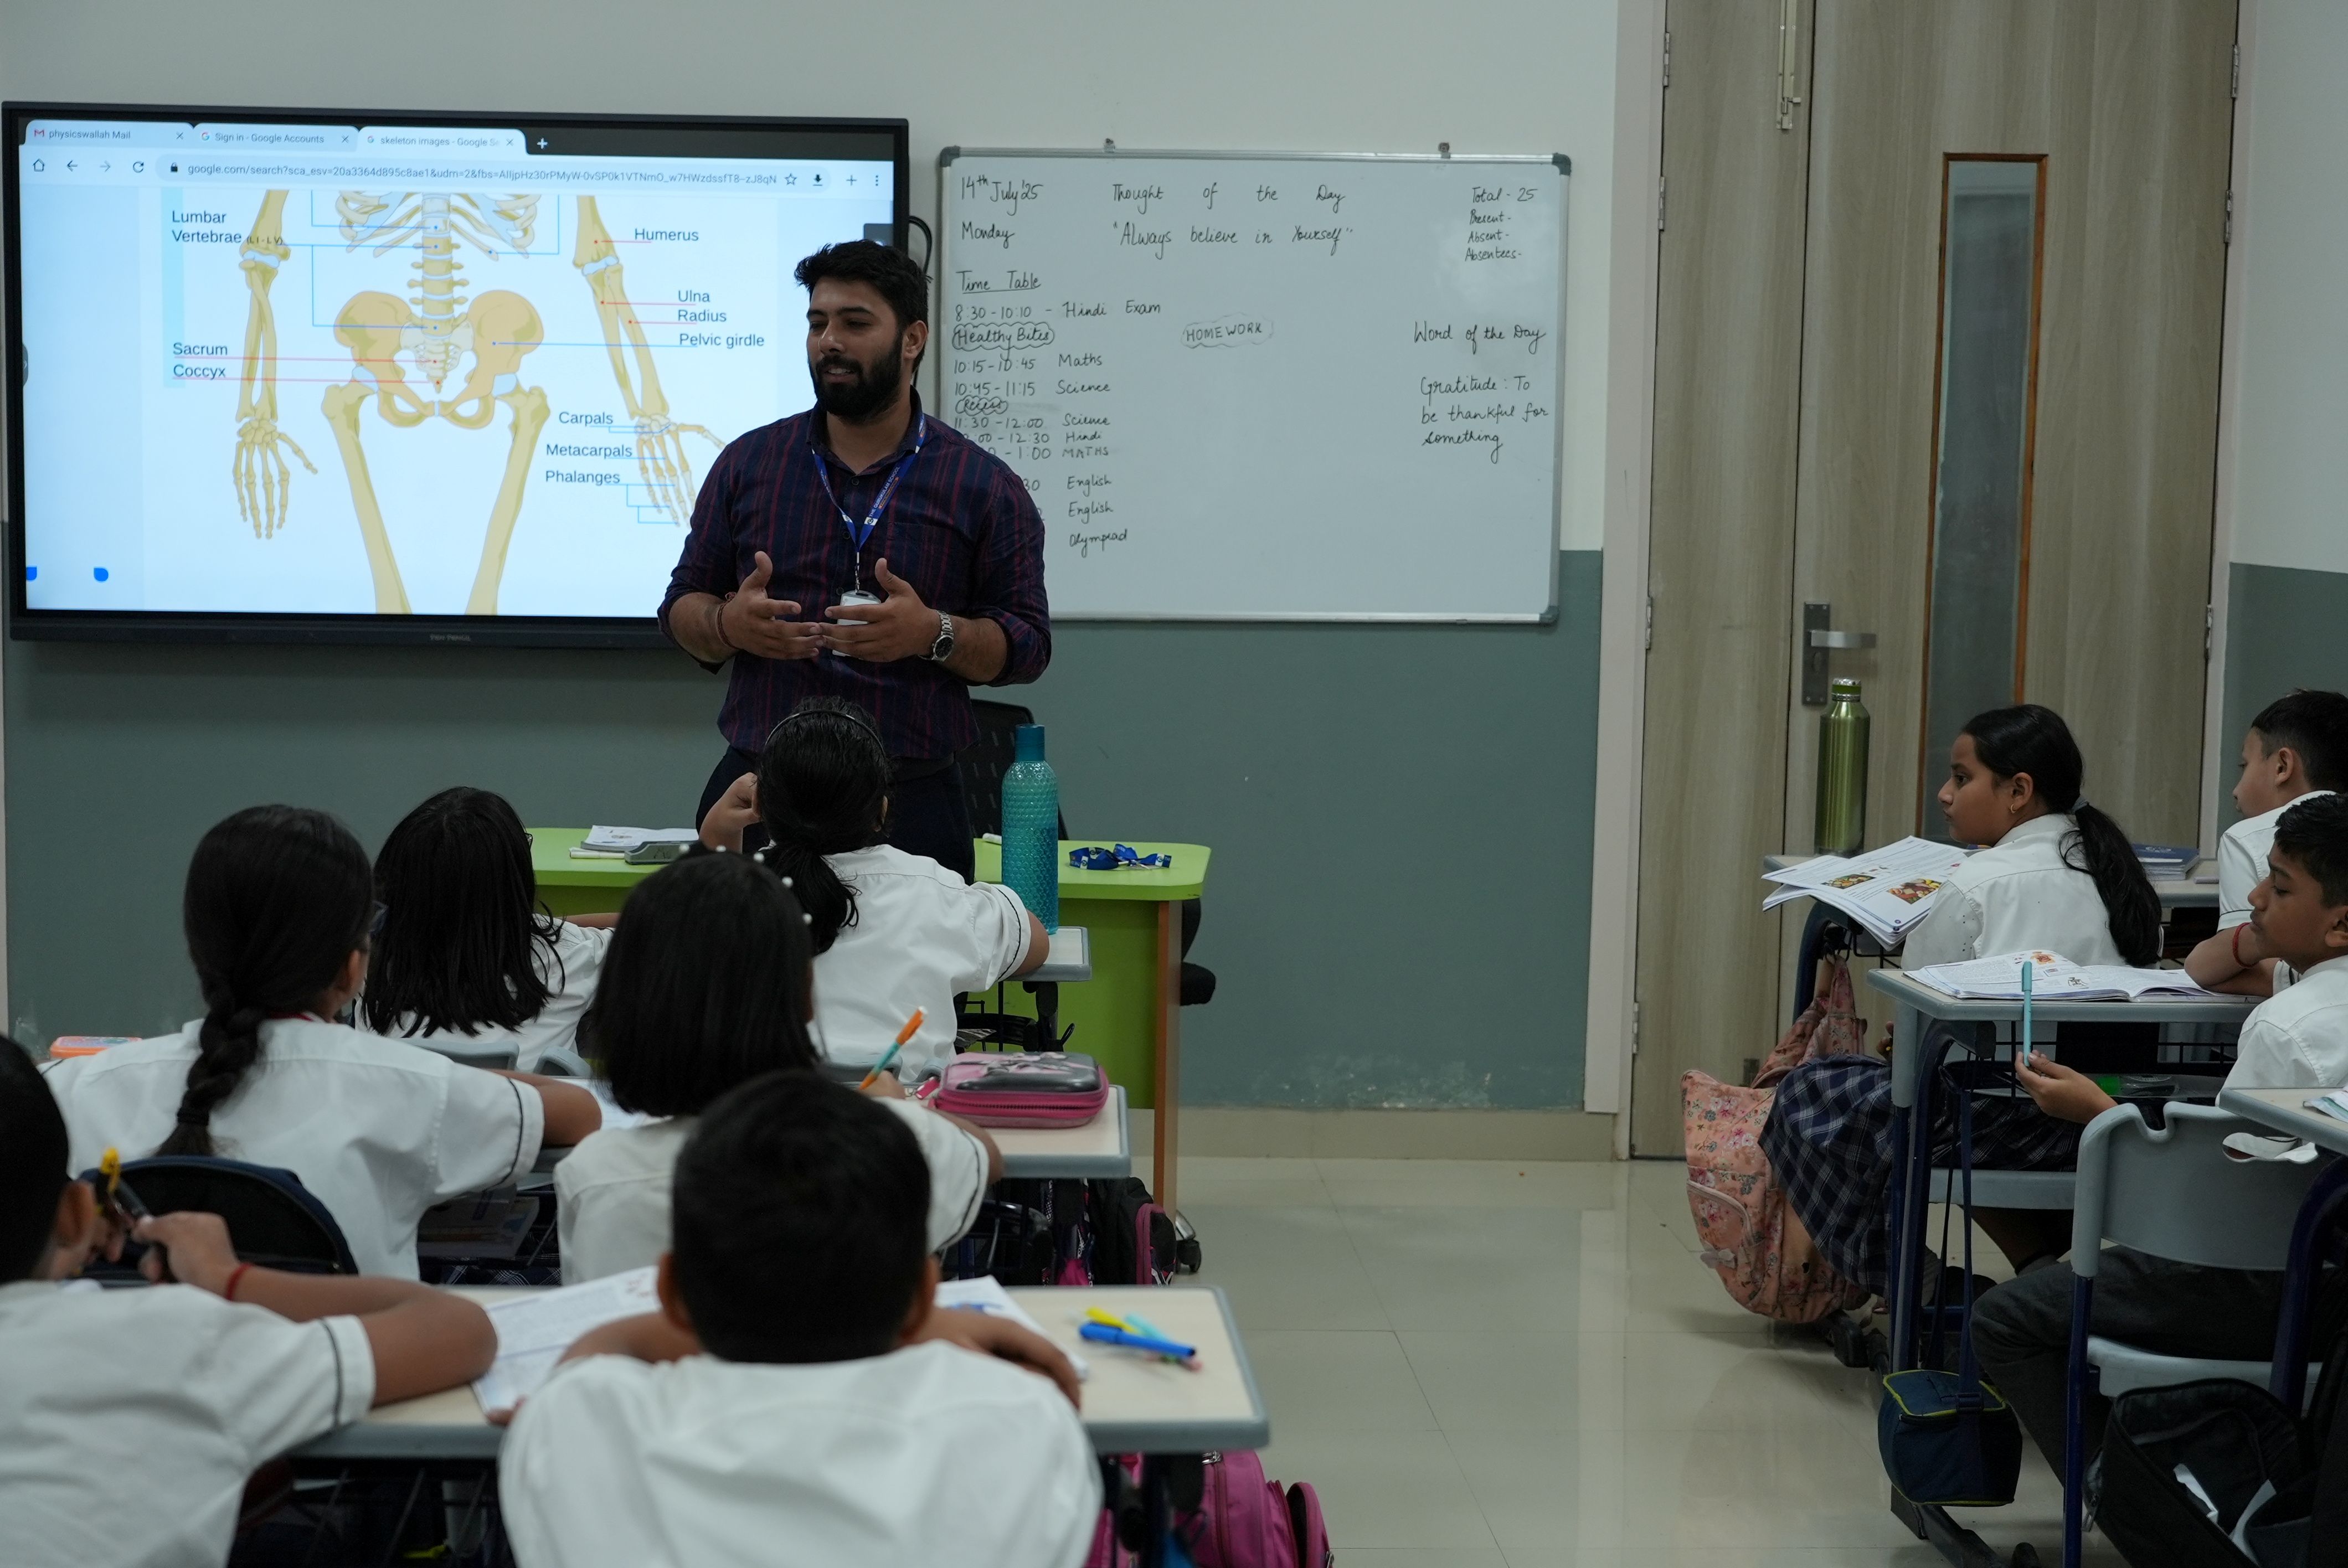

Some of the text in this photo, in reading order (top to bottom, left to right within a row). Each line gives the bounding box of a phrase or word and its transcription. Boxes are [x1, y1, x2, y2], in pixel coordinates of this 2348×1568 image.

[49, 130, 130, 140] physicswallah Mail
[215, 133, 234, 144] Sign
[235, 133, 244, 142] in
[251, 133, 282, 145] Google
[284, 133, 325, 144] Accounts
[380, 137, 416, 146] skeleton
[418, 138, 450, 148] images
[457, 138, 487, 148] Google
[1112, 182, 1346, 215] Thought of the Day
[1471, 186, 1502, 203] Total
[1517, 187, 1538, 202] 25
[172, 210, 226, 224] Lumbar
[172, 229, 241, 244] Vertebrae
[634, 228, 699, 241] Humerus
[961, 221, 1016, 249] Monday
[1190, 226, 1238, 243] believe
[1255, 232, 1273, 244] in
[956, 270, 1042, 292] Time Table
[678, 290, 710, 303] Ulna
[678, 309, 727, 322] Radius
[1062, 301, 1108, 318] Hindi
[1125, 299, 1161, 315] Exam
[679, 333, 765, 350] Pelvic girdle
[957, 327, 1049, 361] Healthy Bites
[1414, 321, 1547, 355] Word of the Day
[173, 342, 228, 355] Sacrum
[1058, 353, 1103, 368] Maths
[173, 364, 226, 378] Coccyx
[1055, 379, 1111, 395] Science
[1513, 375, 1530, 391] To
[559, 411, 613, 426] Carpals
[1062, 412, 1111, 427] Science
[1422, 403, 1549, 425] be thankful for
[1065, 431, 1102, 444] Hindi
[546, 443, 632, 458] Metacarpals
[1062, 446, 1109, 459] MATHS
[1421, 430, 1503, 464] something
[546, 470, 620, 486] Phalanges
[1067, 474, 1113, 497] English
[1068, 501, 1114, 525] English
